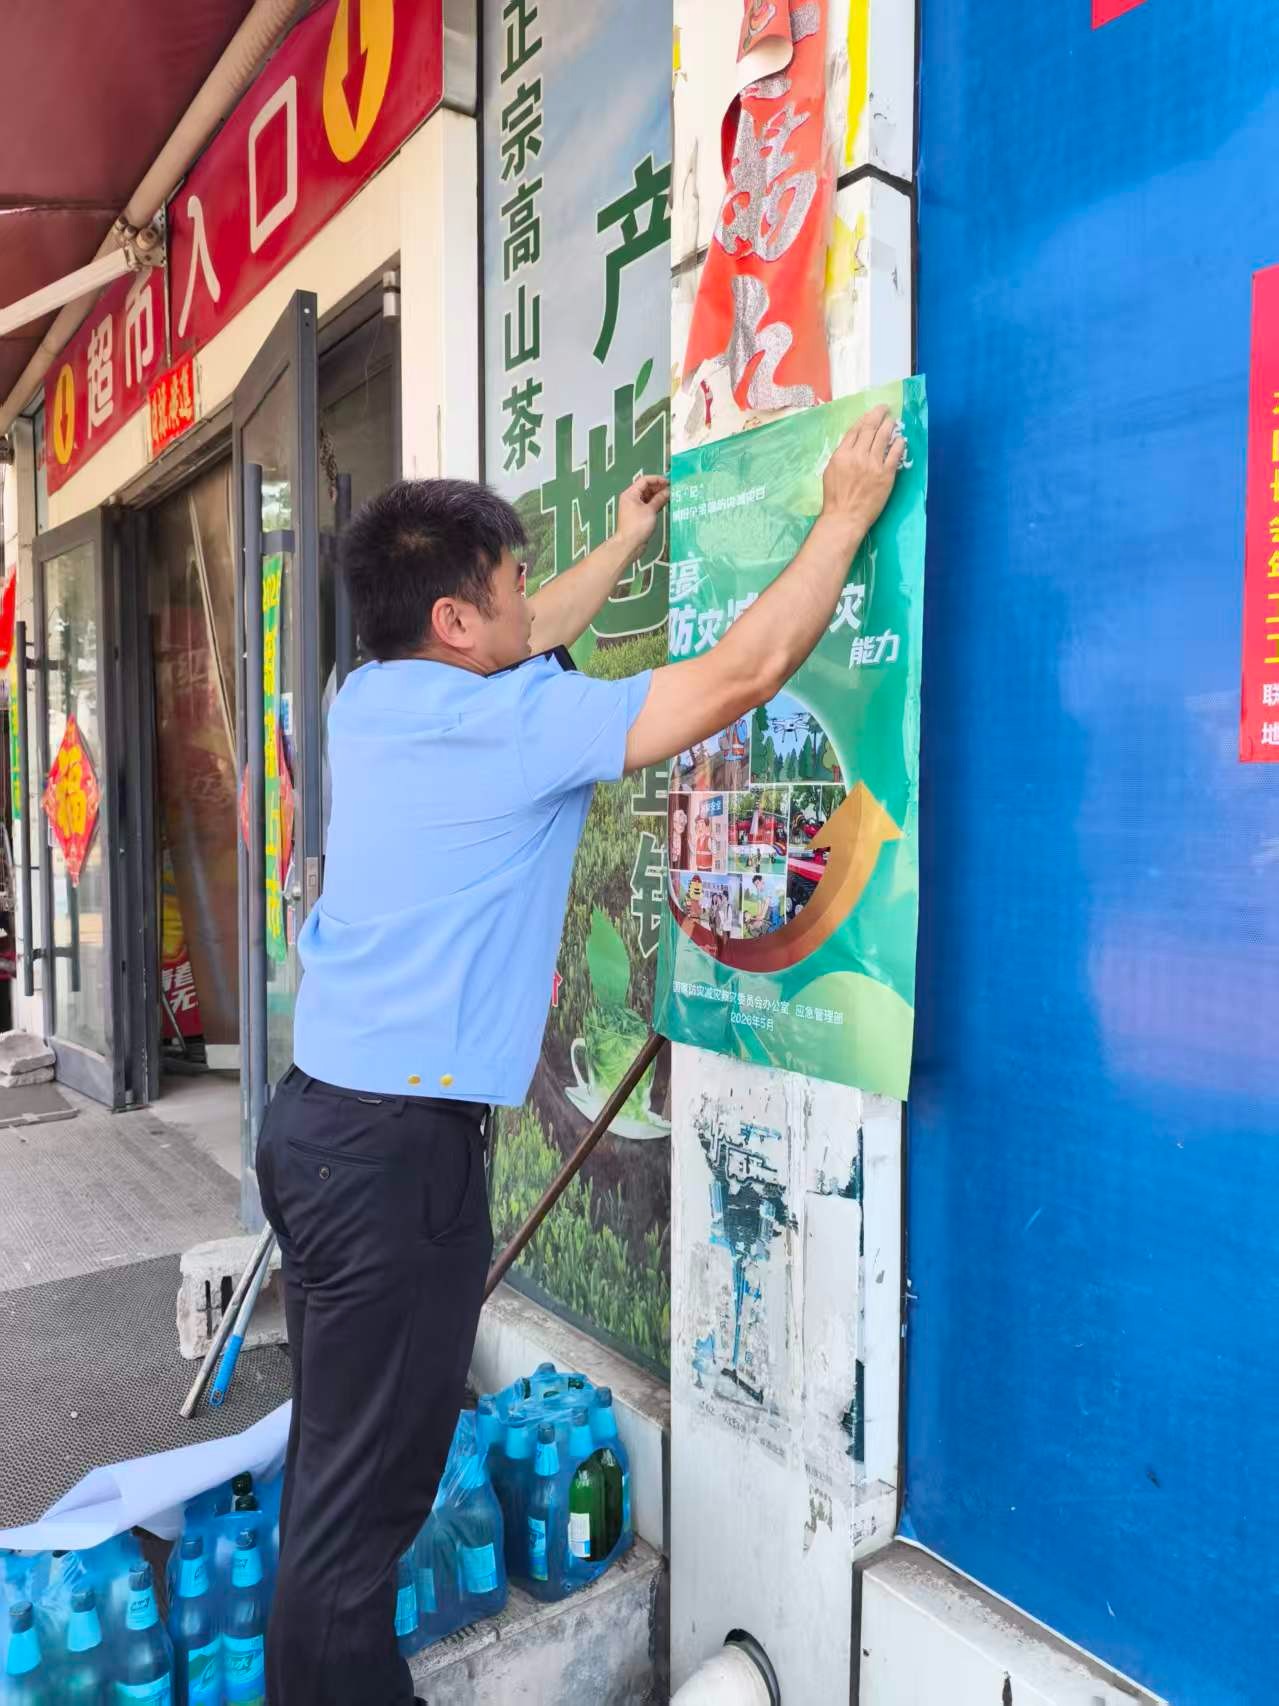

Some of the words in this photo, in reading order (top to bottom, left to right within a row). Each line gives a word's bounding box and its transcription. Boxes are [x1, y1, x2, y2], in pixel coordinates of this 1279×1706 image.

[500, 0, 544, 472] 正宗高山茶
[848, 628, 901, 671] 能力
[795, 1004, 844, 1026] 应急管理部
